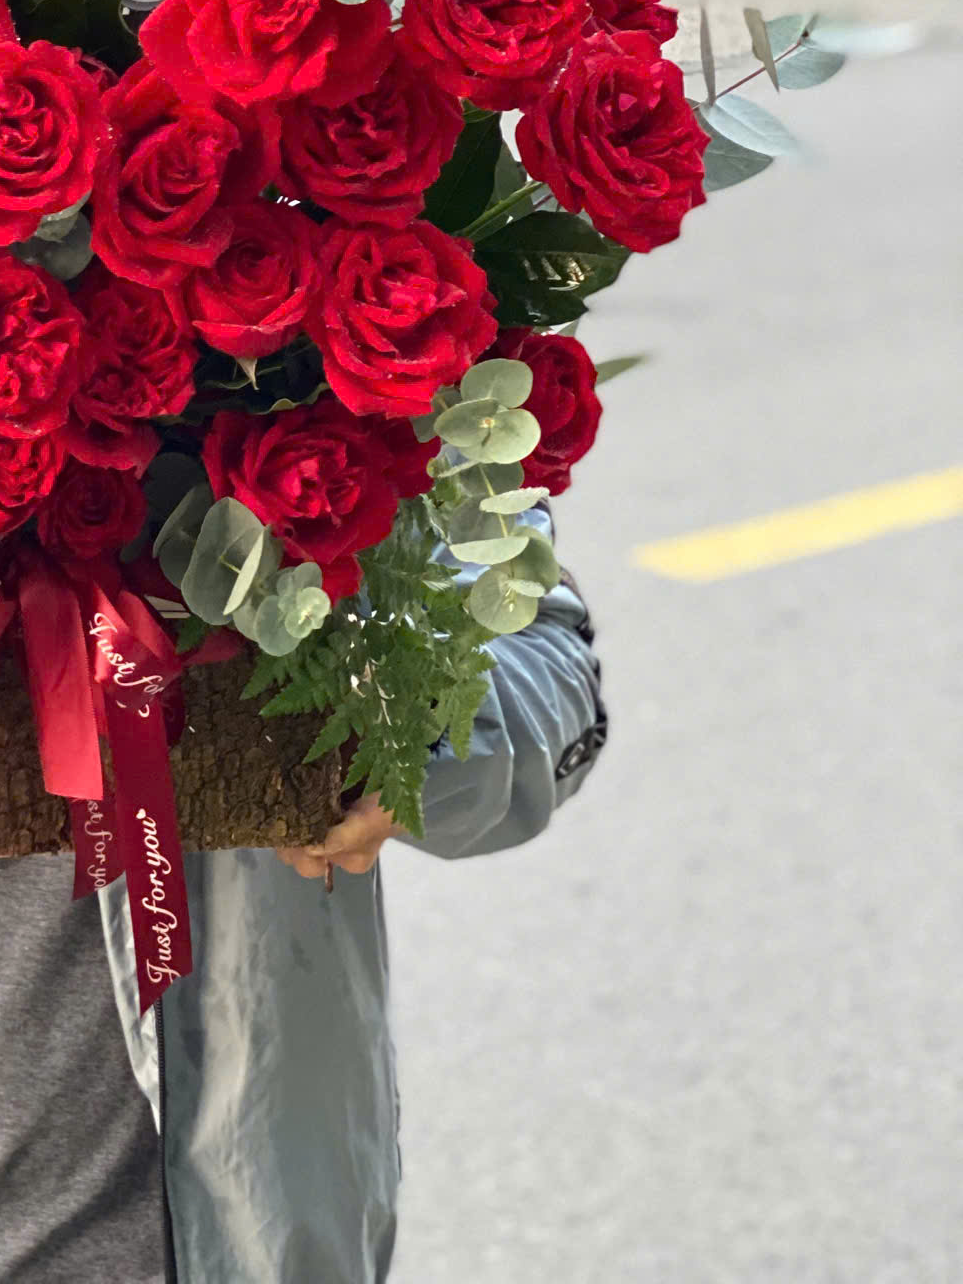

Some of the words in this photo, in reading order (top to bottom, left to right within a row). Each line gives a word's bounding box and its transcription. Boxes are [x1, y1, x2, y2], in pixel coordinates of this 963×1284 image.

[88, 611, 137, 675] Just
[142, 816, 172, 876] you
[141, 869, 178, 930] for
[146, 921, 182, 984] Just
